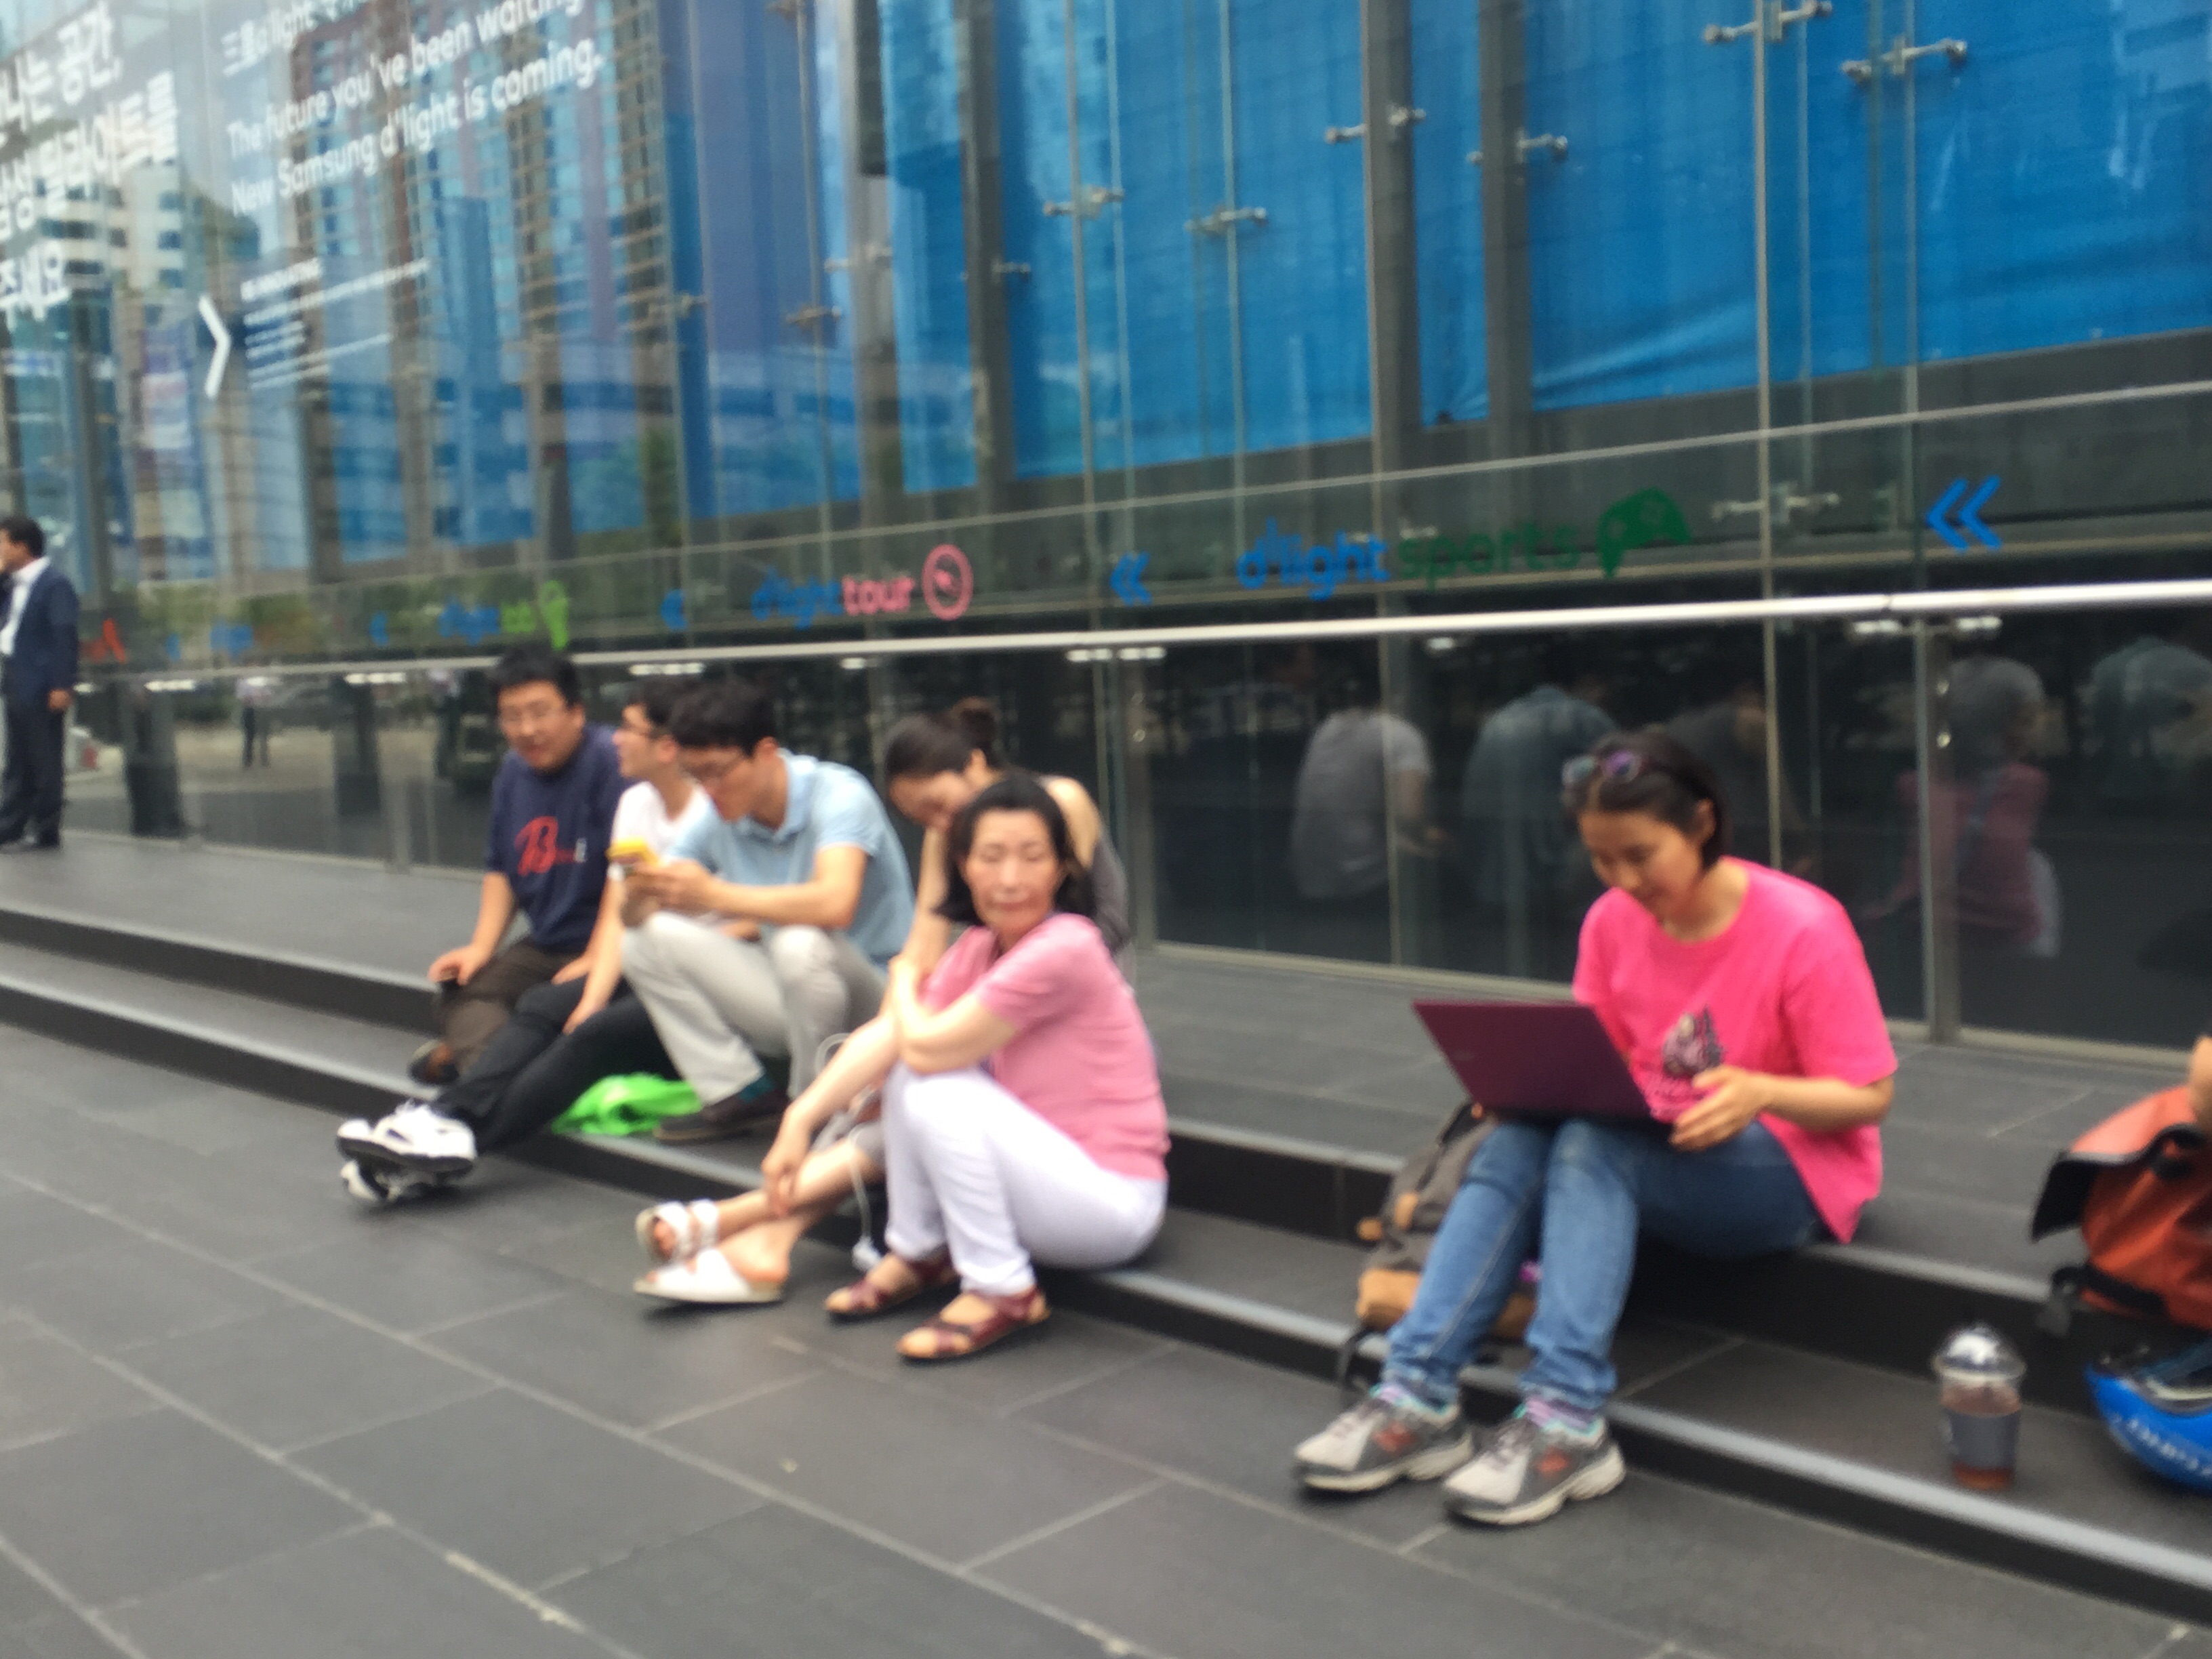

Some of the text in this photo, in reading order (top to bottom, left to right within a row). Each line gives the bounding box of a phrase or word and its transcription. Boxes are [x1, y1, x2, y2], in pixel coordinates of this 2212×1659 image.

[226, 121, 263, 159] The
[266, 89, 328, 141] future
[331, 52, 405, 126] you've
[411, 20, 472, 77] been
[230, 178, 274, 219] New
[278, 134, 379, 200] Samsung
[464, 76, 489, 121] is
[491, 38, 605, 112] coming.
